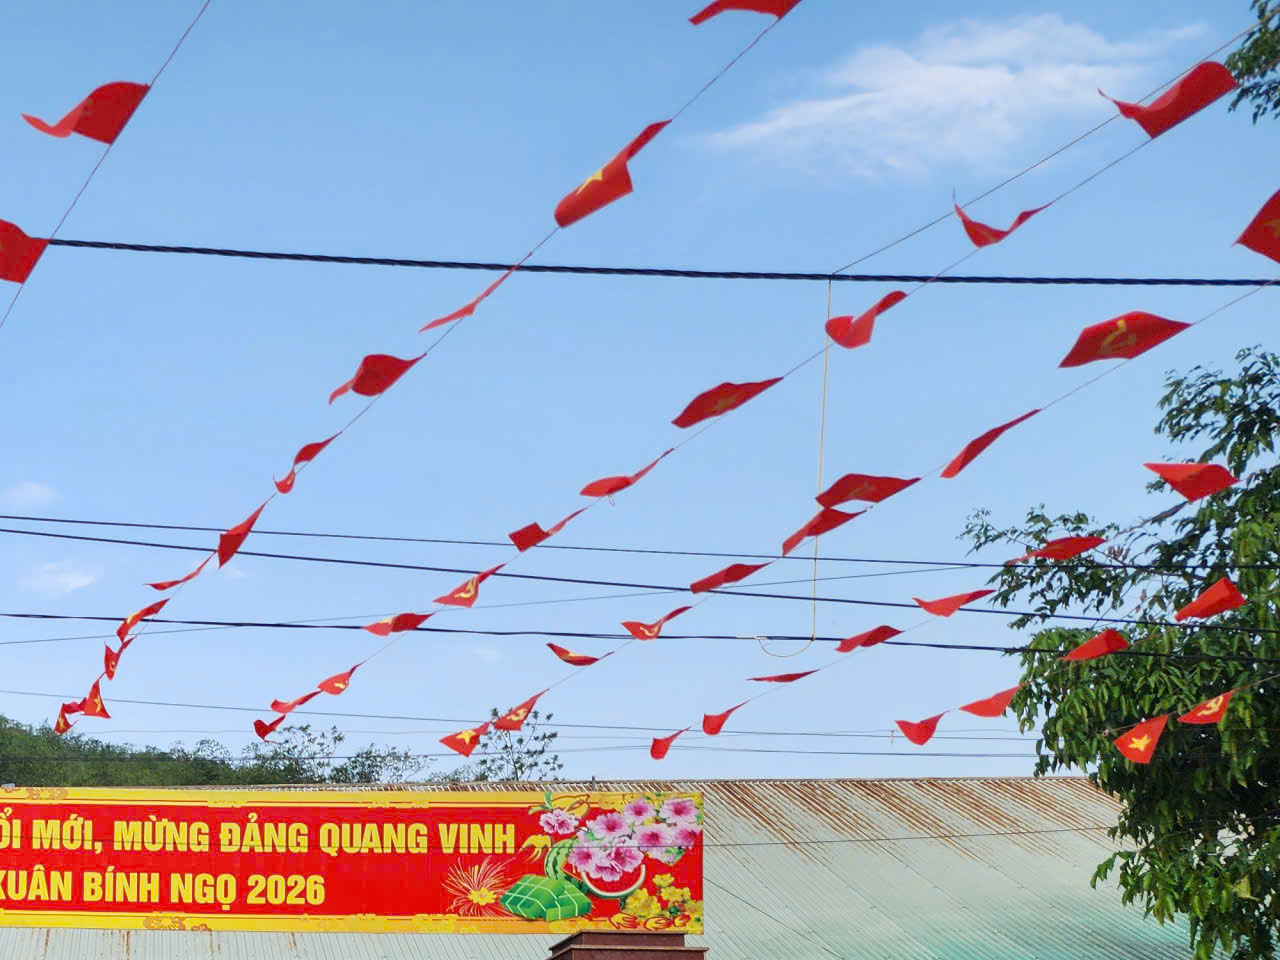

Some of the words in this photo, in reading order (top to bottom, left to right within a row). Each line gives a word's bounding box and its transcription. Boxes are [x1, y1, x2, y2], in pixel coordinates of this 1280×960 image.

[32, 812, 103, 854] MỚI,
[113, 814, 210, 852] MỪNG
[219, 812, 308, 853] ĐẢNG
[319, 822, 428, 857] QUANG
[438, 823, 515, 854] VINH
[83, 865, 160, 903] BÍNH
[170, 872, 237, 911] NGỌ
[246, 874, 326, 905] 2026
